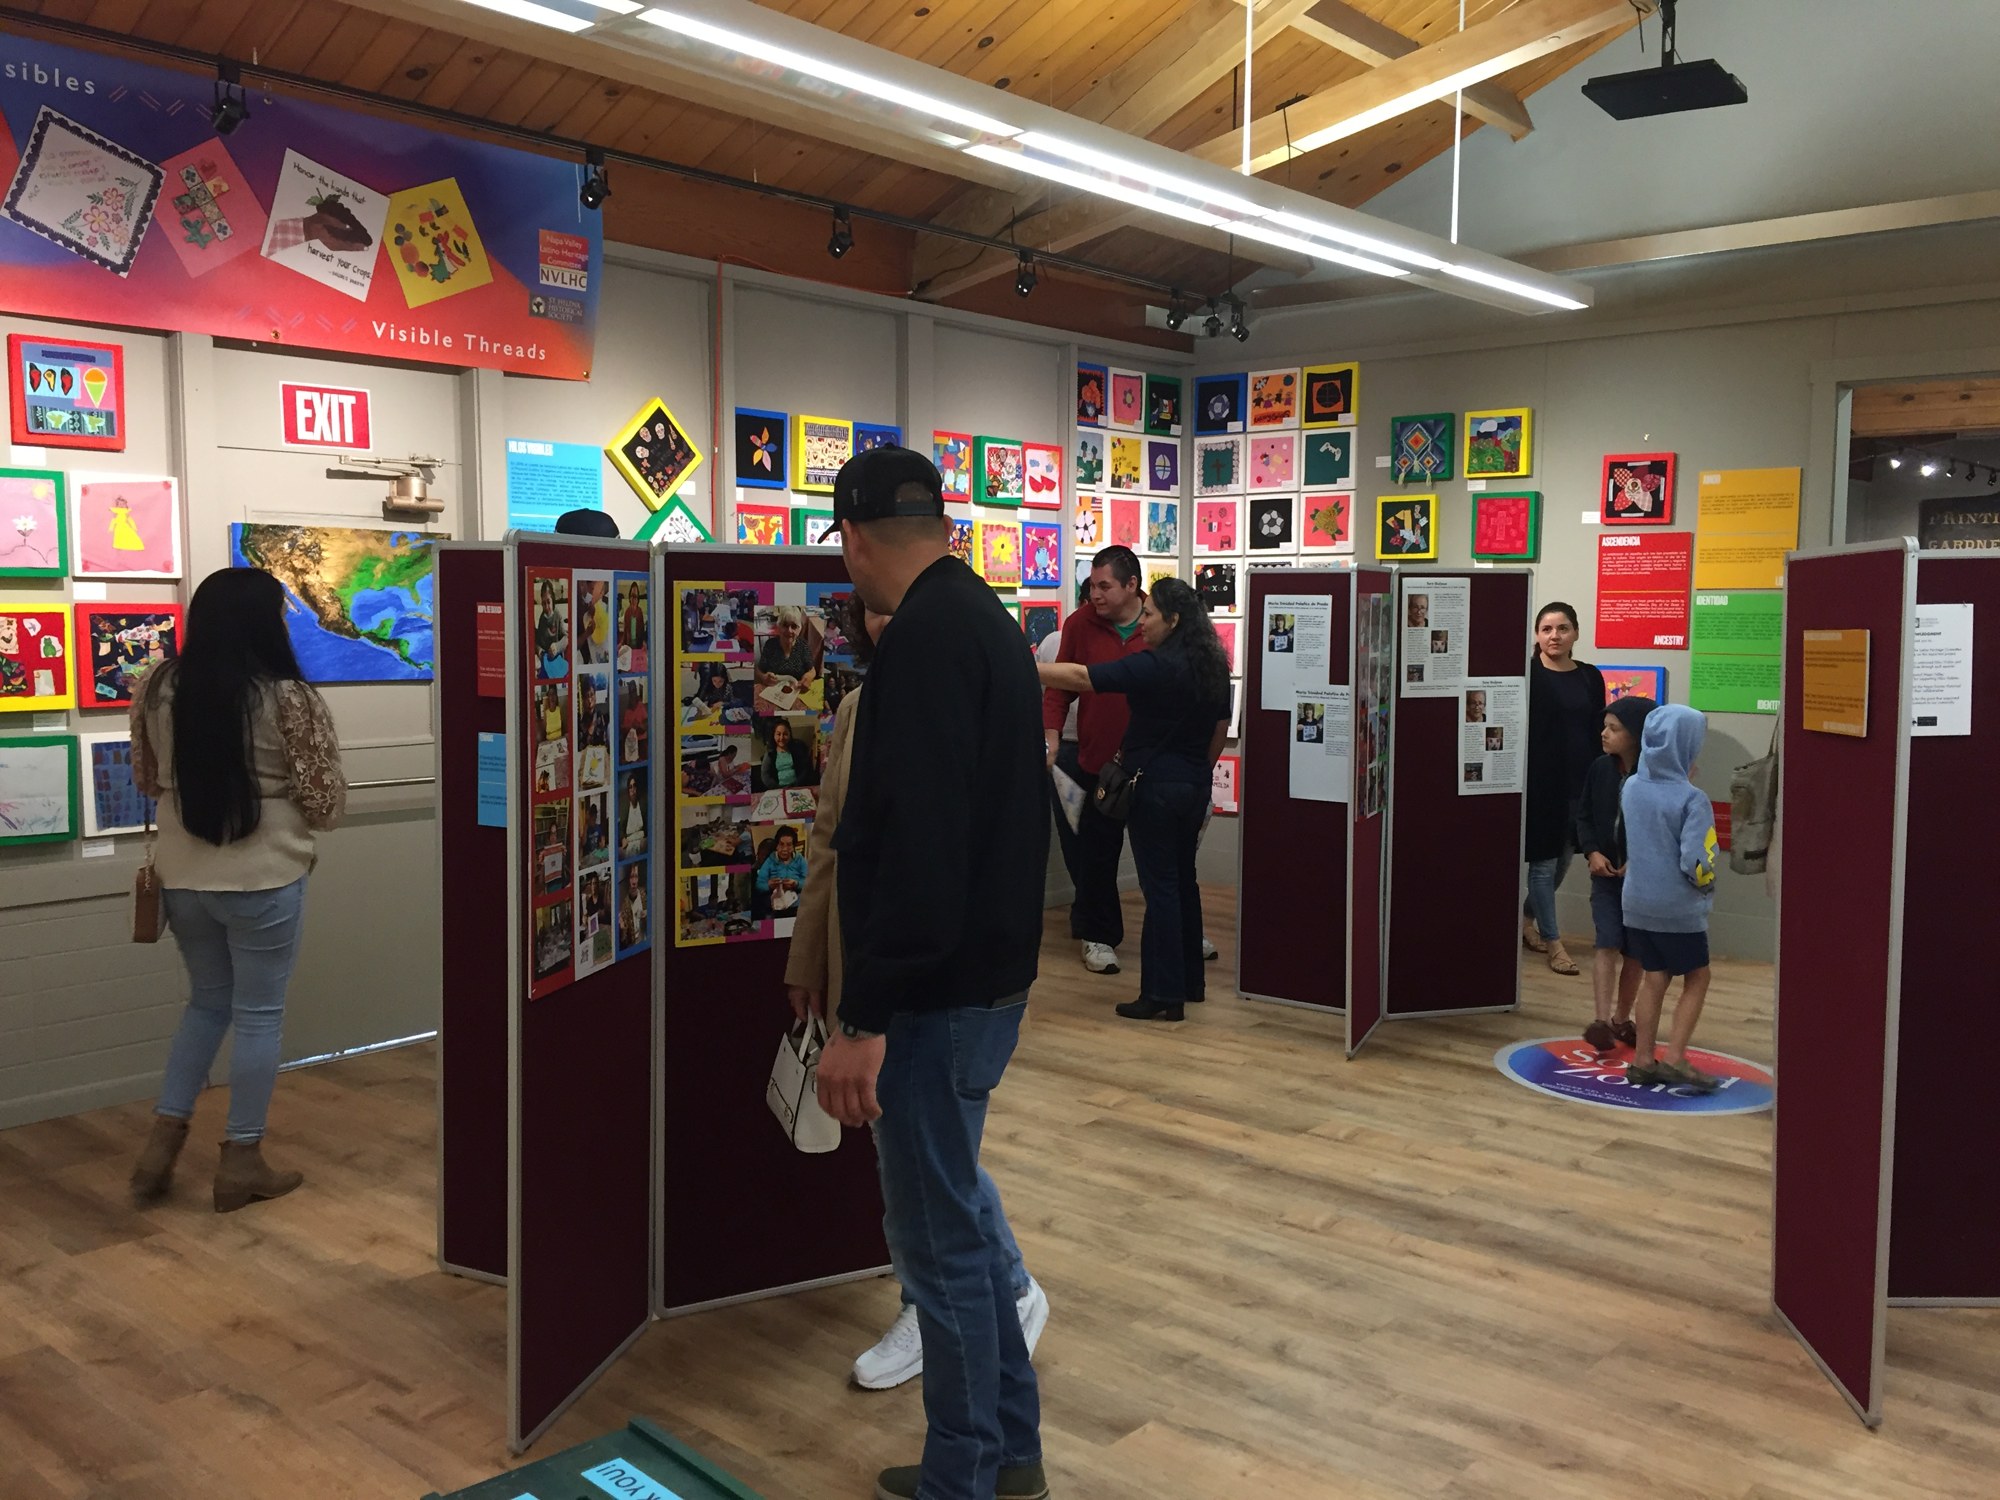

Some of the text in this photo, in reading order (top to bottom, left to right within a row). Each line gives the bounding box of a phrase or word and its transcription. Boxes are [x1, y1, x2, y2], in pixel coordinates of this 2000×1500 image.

[5, 62, 95, 95] sibles
[293, 162, 366, 205] Honor the hands that
[546, 235, 582, 249] Napa Valley
[307, 243, 334, 262] harvest
[337, 256, 351, 270] your
[540, 245, 589, 262] Latino Heritage
[547, 256, 582, 269] Committee
[540, 268, 586, 288] NVLHC
[372, 320, 546, 361] Visible Threads
[295, 390, 356, 443] EXIT
[1929, 511, 2000, 525] PRINTI
[1928, 539, 2000, 550] GARDNE
[1653, 635, 1684, 646] ANCESTRY
[596, 1463, 646, 1496] YOU!
